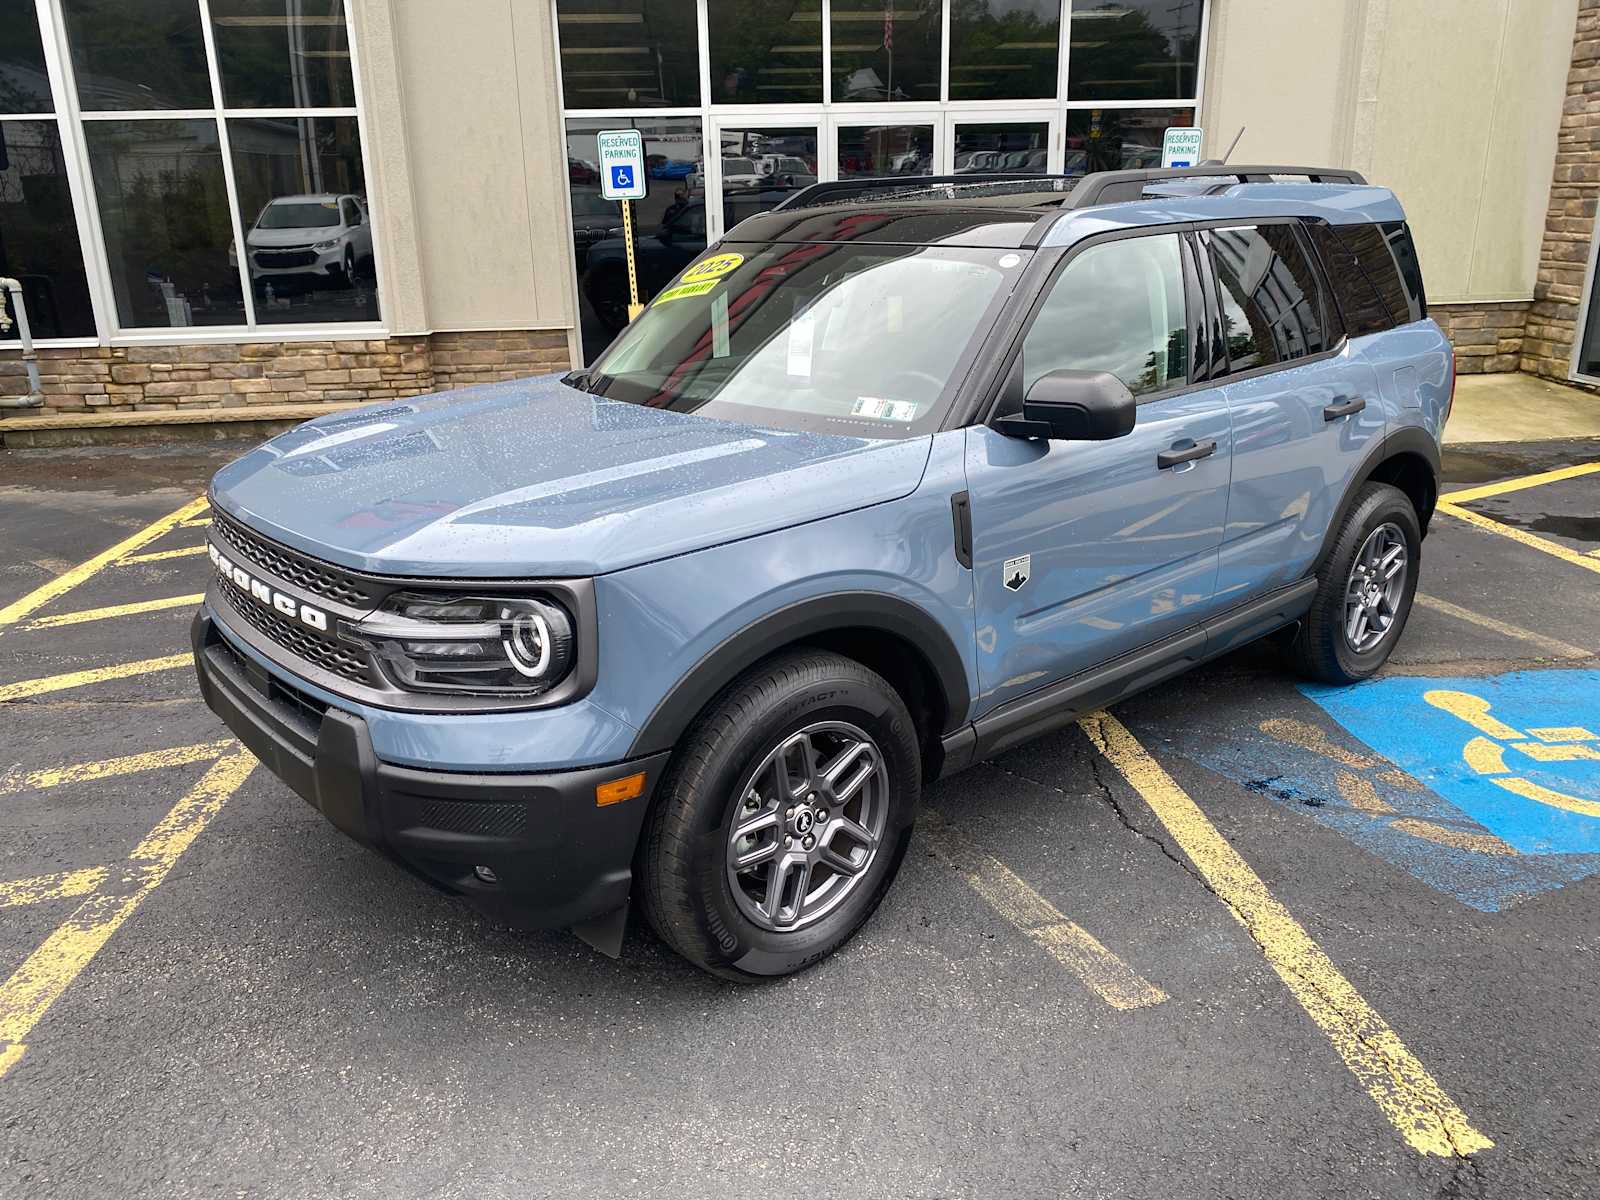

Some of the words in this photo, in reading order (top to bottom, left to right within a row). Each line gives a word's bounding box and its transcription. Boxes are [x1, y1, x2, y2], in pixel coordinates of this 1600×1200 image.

[601, 136, 638, 148] RESERVED
[1167, 134, 1200, 144] RESERVED
[604, 148, 637, 159] PARKING
[1168, 145, 1196, 155] PARKING
[208, 543, 327, 631] BRONCO
